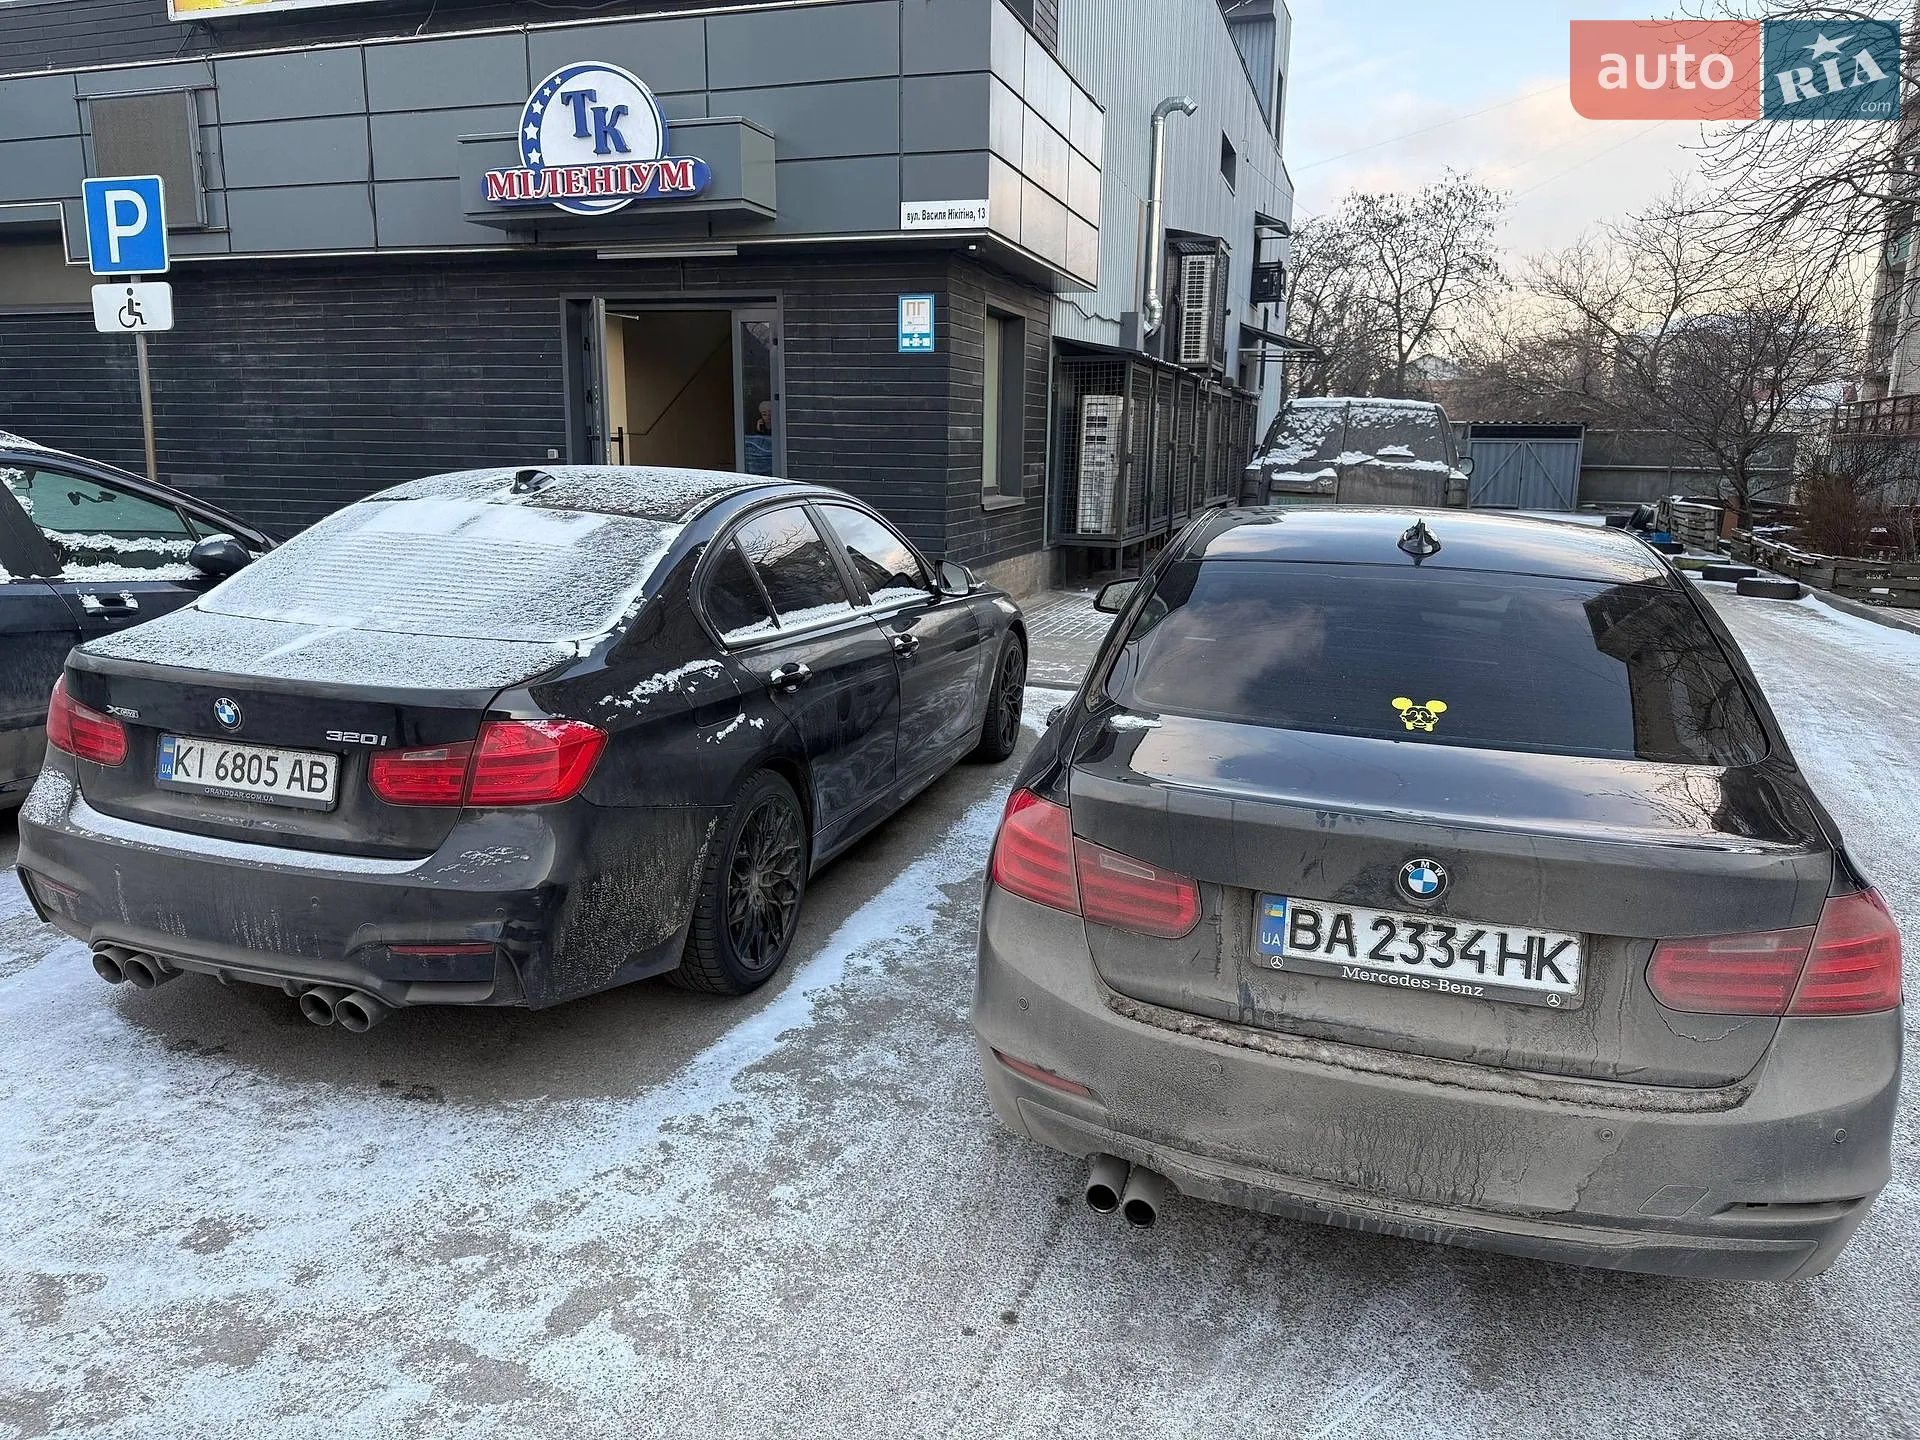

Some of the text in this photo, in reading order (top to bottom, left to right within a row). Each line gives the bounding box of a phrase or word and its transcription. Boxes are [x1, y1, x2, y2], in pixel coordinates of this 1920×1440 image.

[486, 160, 695, 200] МІЛЕНІУМ
[104, 189, 148, 263] P
[906, 212, 921, 224] вул.
[922, 209, 947, 221] Василя
[978, 207, 986, 219] 13
[161, 764, 172, 776] UA
[174, 744, 328, 794] KI 6805 AB
[1405, 860, 1445, 877] BMW
[1262, 931, 1281, 947] UA
[1288, 907, 1357, 958] BA
[1341, 965, 1484, 998] Mercedes-Benz
